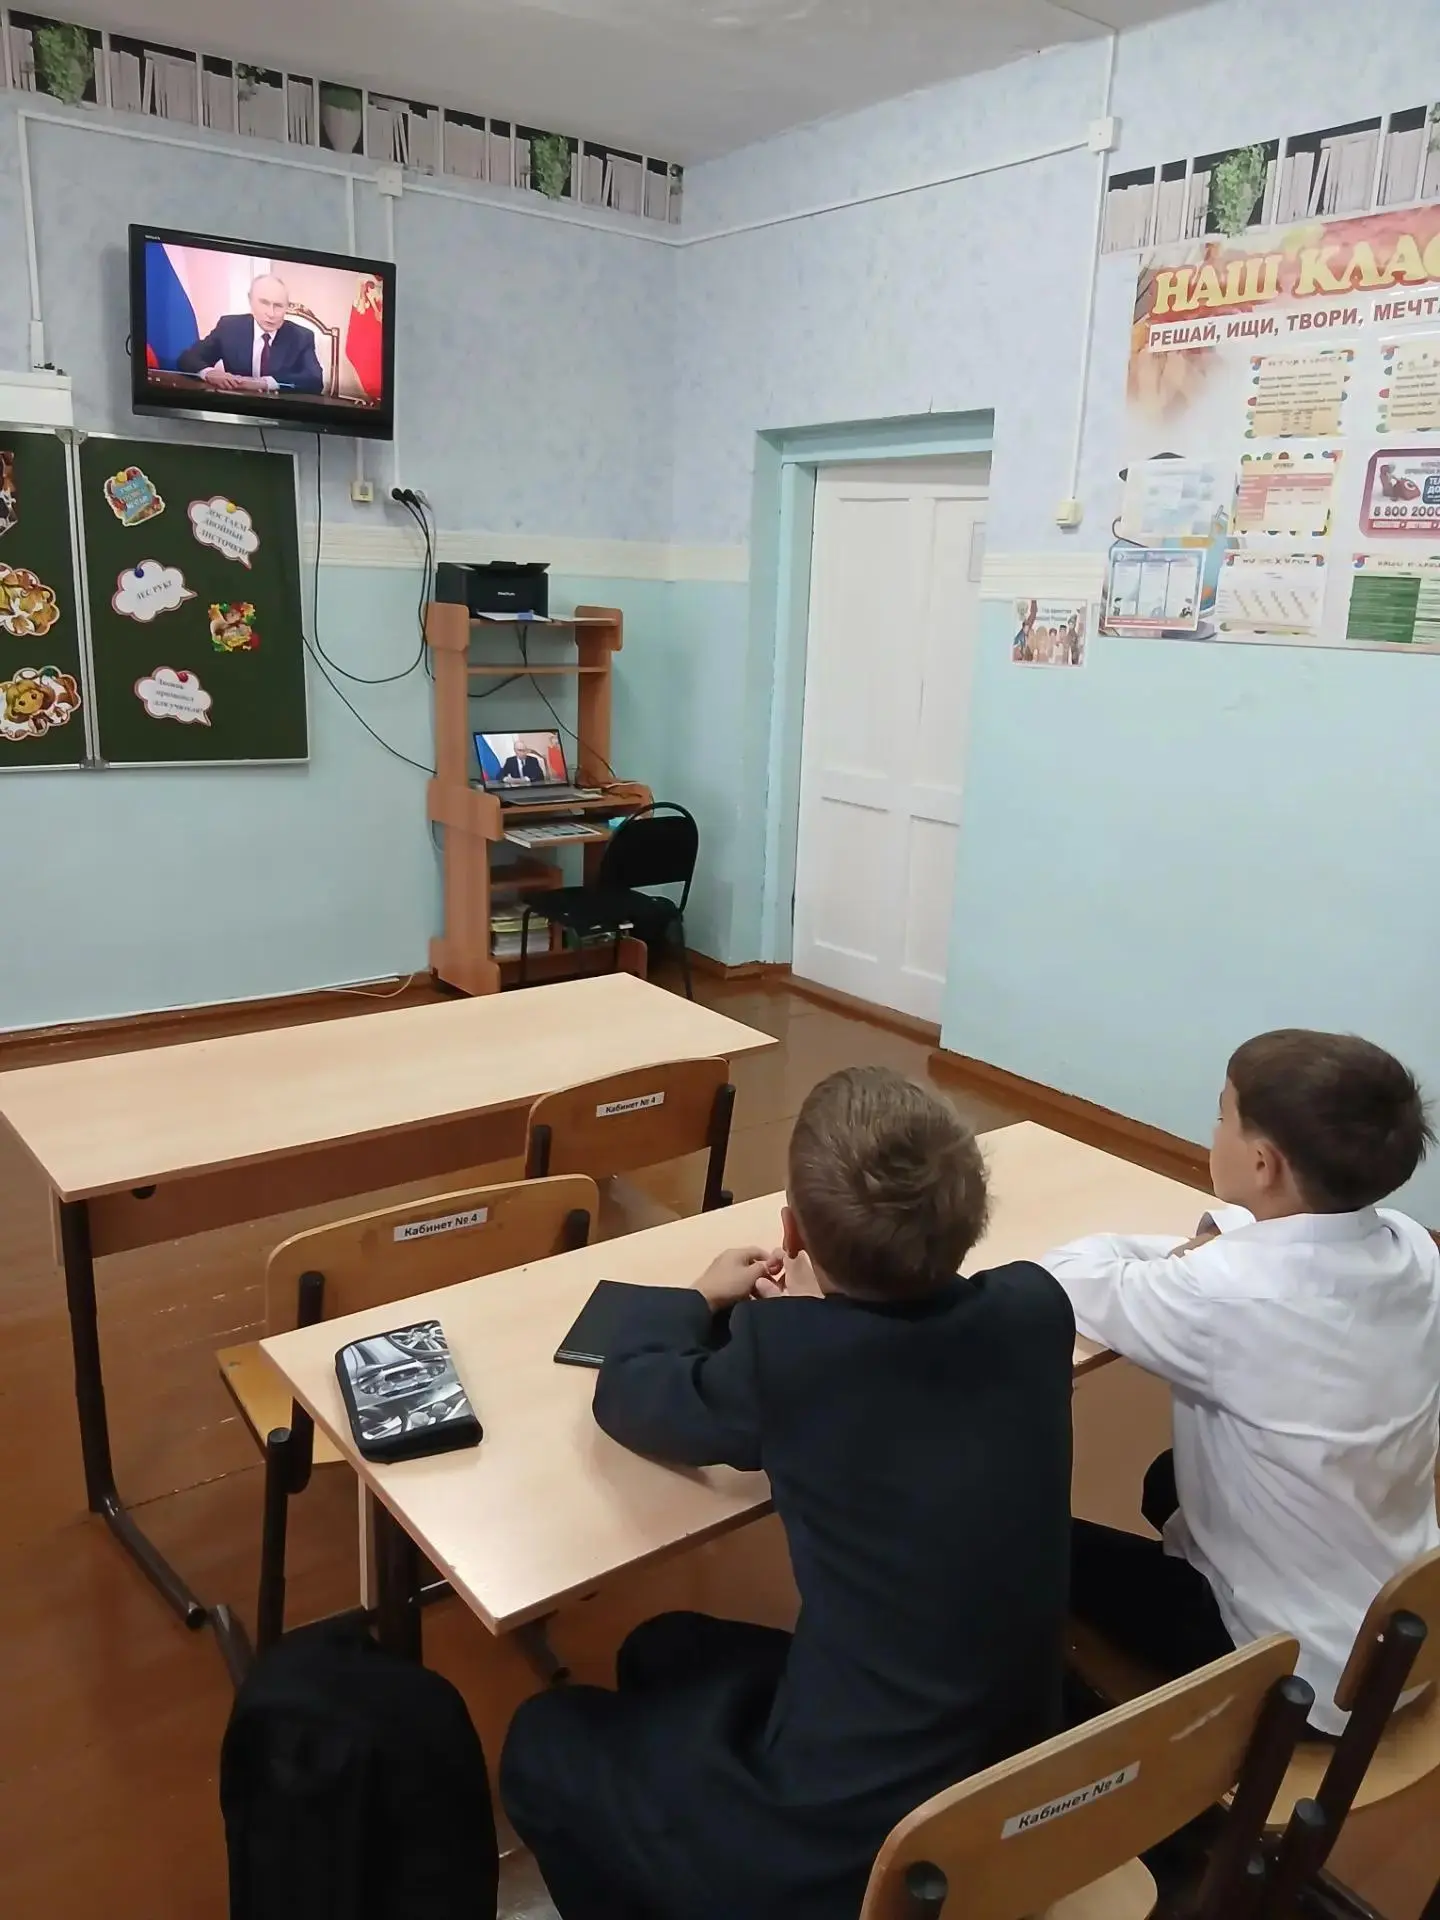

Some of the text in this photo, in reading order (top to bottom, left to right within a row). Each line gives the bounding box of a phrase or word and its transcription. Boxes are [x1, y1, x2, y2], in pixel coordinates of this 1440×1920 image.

[1152, 253, 1283, 314] НАШ
[1150, 297, 1440, 347] РЕШАЙ, ИЩИ, ТВОРИ, МЕЧТ
[1373, 506, 1381, 517] 8
[1384, 506, 1408, 517] 800
[605, 1101, 638, 1114] Кабинет
[651, 1096, 656, 1104] 4
[404, 1213, 478, 1237] Кабинет № 4
[1018, 1772, 1125, 1829] Кабинет № 4
